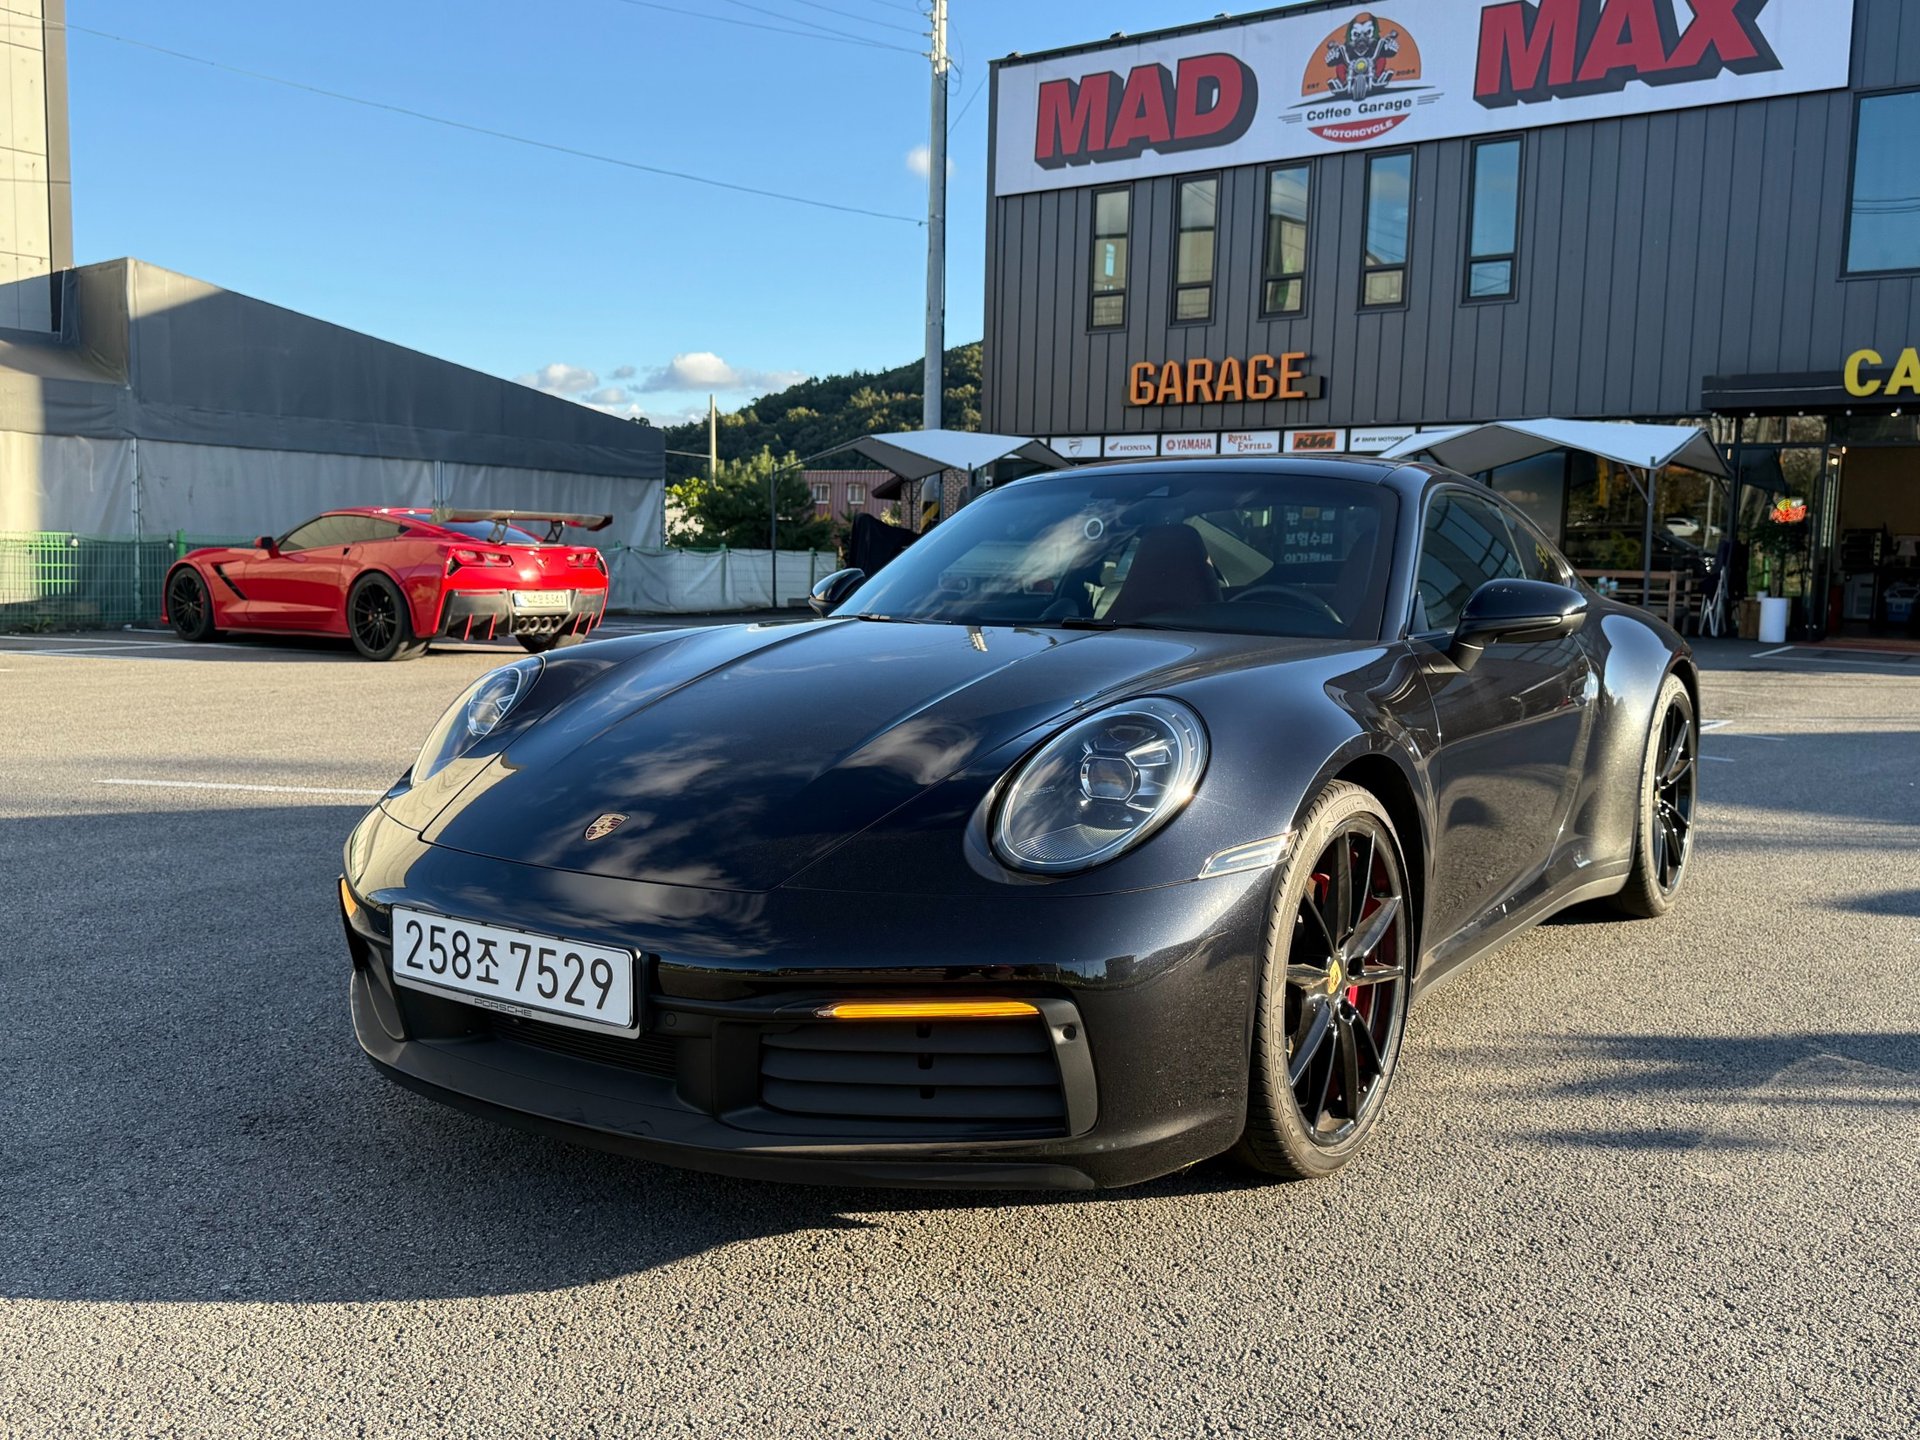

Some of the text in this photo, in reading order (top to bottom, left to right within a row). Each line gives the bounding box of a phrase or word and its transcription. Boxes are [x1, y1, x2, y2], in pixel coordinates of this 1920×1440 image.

[1034, 0, 1780, 168] MAD MAX
[1307, 98, 1412, 121] Coffee Garage
[1323, 119, 1394, 138] MOTORCYCLE
[1130, 351, 1306, 405] GARAGE
[1120, 443, 1152, 451] HONDA
[1177, 438, 1212, 450] YAMAHA
[1227, 433, 1253, 444] ROYAL
[1237, 441, 1272, 452] ENFIELD
[1295, 432, 1333, 448] KTM
[474, 998, 532, 1017] PORSCHE
